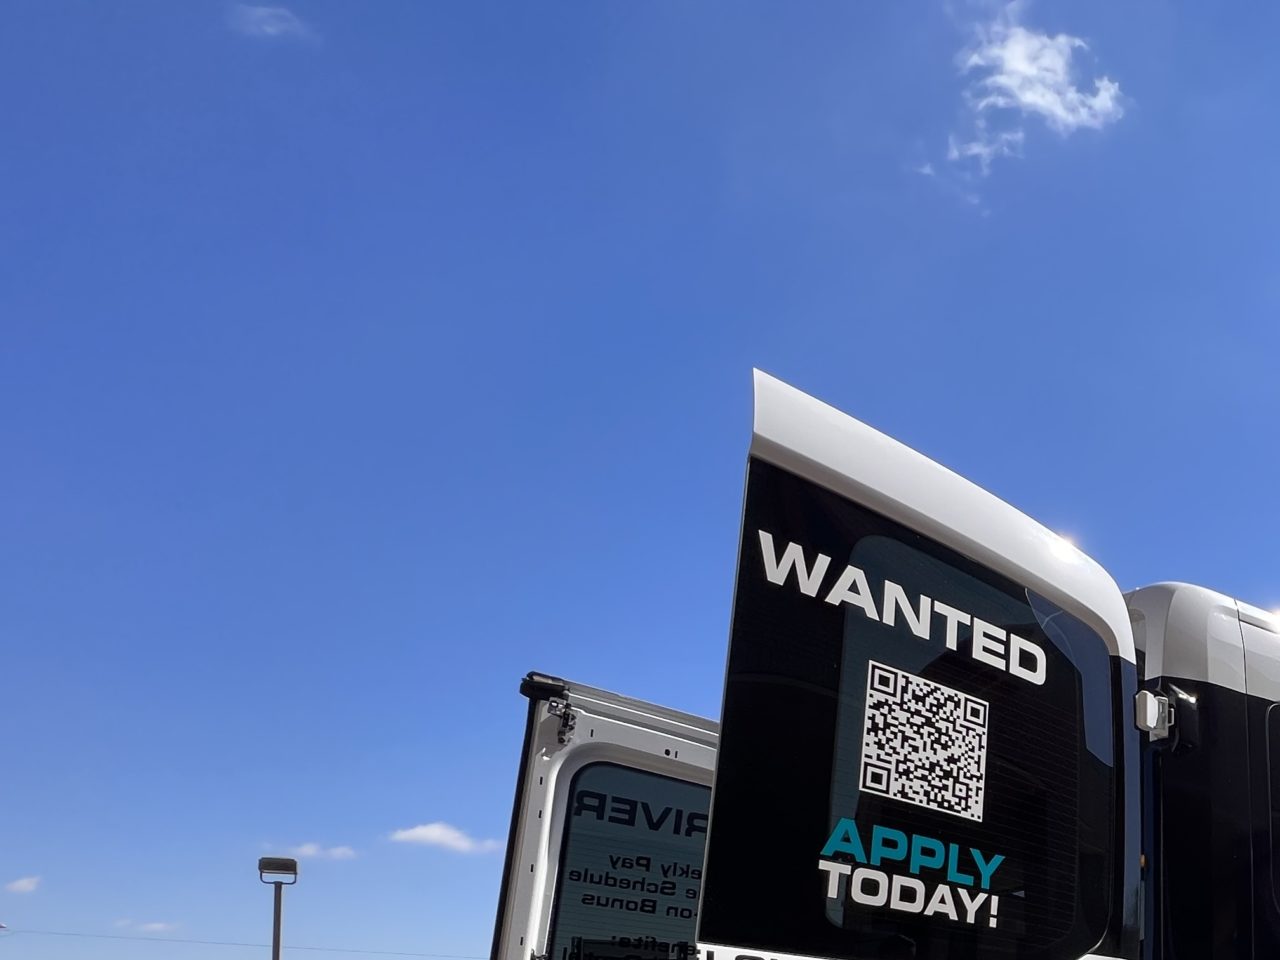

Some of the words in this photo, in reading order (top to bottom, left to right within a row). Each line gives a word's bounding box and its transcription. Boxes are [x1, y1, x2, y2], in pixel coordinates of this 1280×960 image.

[758, 529, 1047, 686] WANTED
[821, 817, 1006, 890] APPLY
[818, 859, 999, 929] TODAY!
